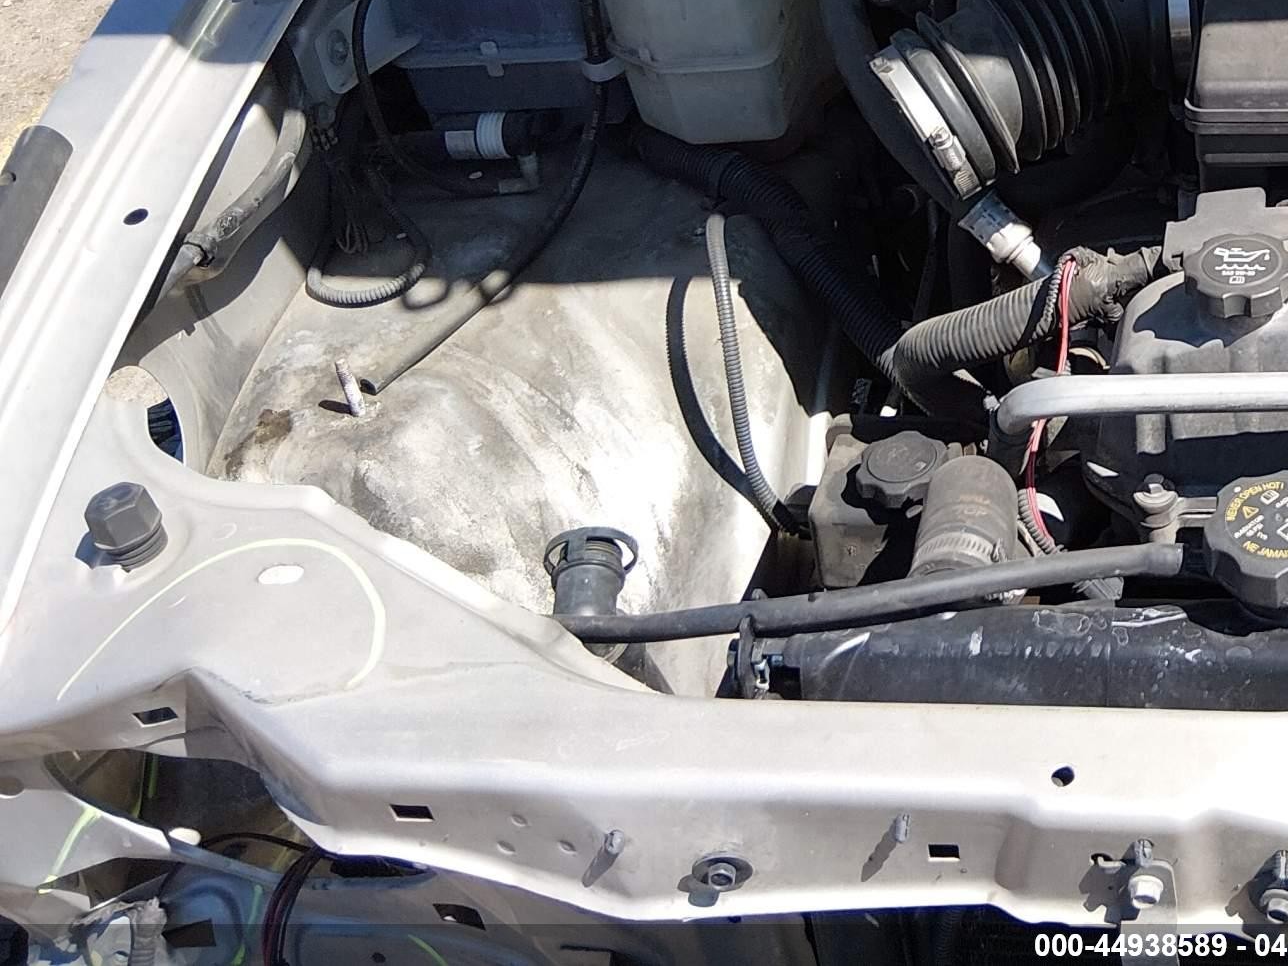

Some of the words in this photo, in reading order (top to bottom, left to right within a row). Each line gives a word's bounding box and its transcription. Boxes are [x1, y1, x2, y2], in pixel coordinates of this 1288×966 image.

[1239, 484, 1262, 501] OPEN
[1261, 481, 1284, 491] HOT!
[1242, 540, 1260, 553] NE
